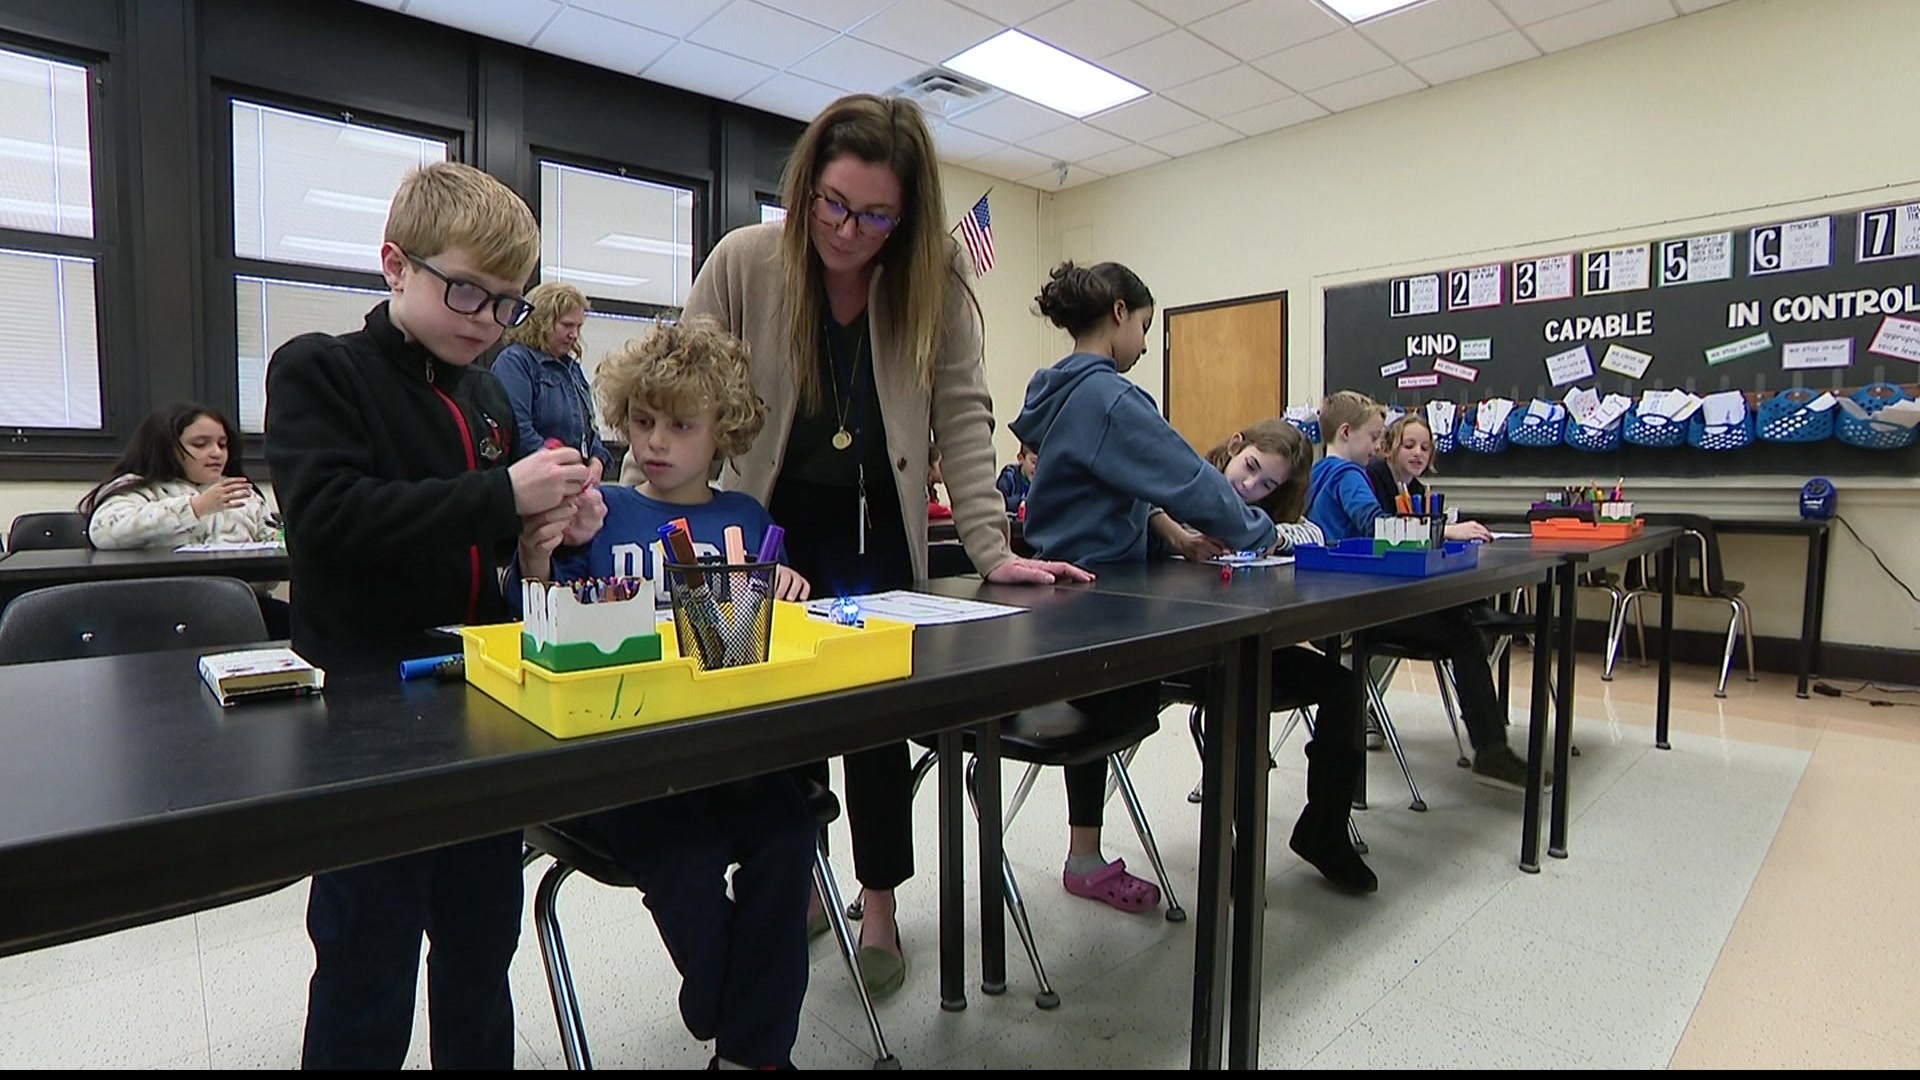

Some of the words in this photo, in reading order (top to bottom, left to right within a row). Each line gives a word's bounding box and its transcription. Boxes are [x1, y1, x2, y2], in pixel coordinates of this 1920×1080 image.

[1755, 229, 1779, 268] 6
[1868, 212, 1889, 255] 7
[1588, 253, 1610, 289] 4
[1665, 242, 1688, 280] 5
[1399, 281, 1406, 312] 1
[1453, 272, 1467, 304] 2
[1518, 263, 1534, 298] 3
[1727, 301, 1760, 328] IN
[1772, 284, 1920, 323] CONTROL
[1544, 310, 1653, 343] CAPABLE
[1406, 333, 1458, 357] KIND
